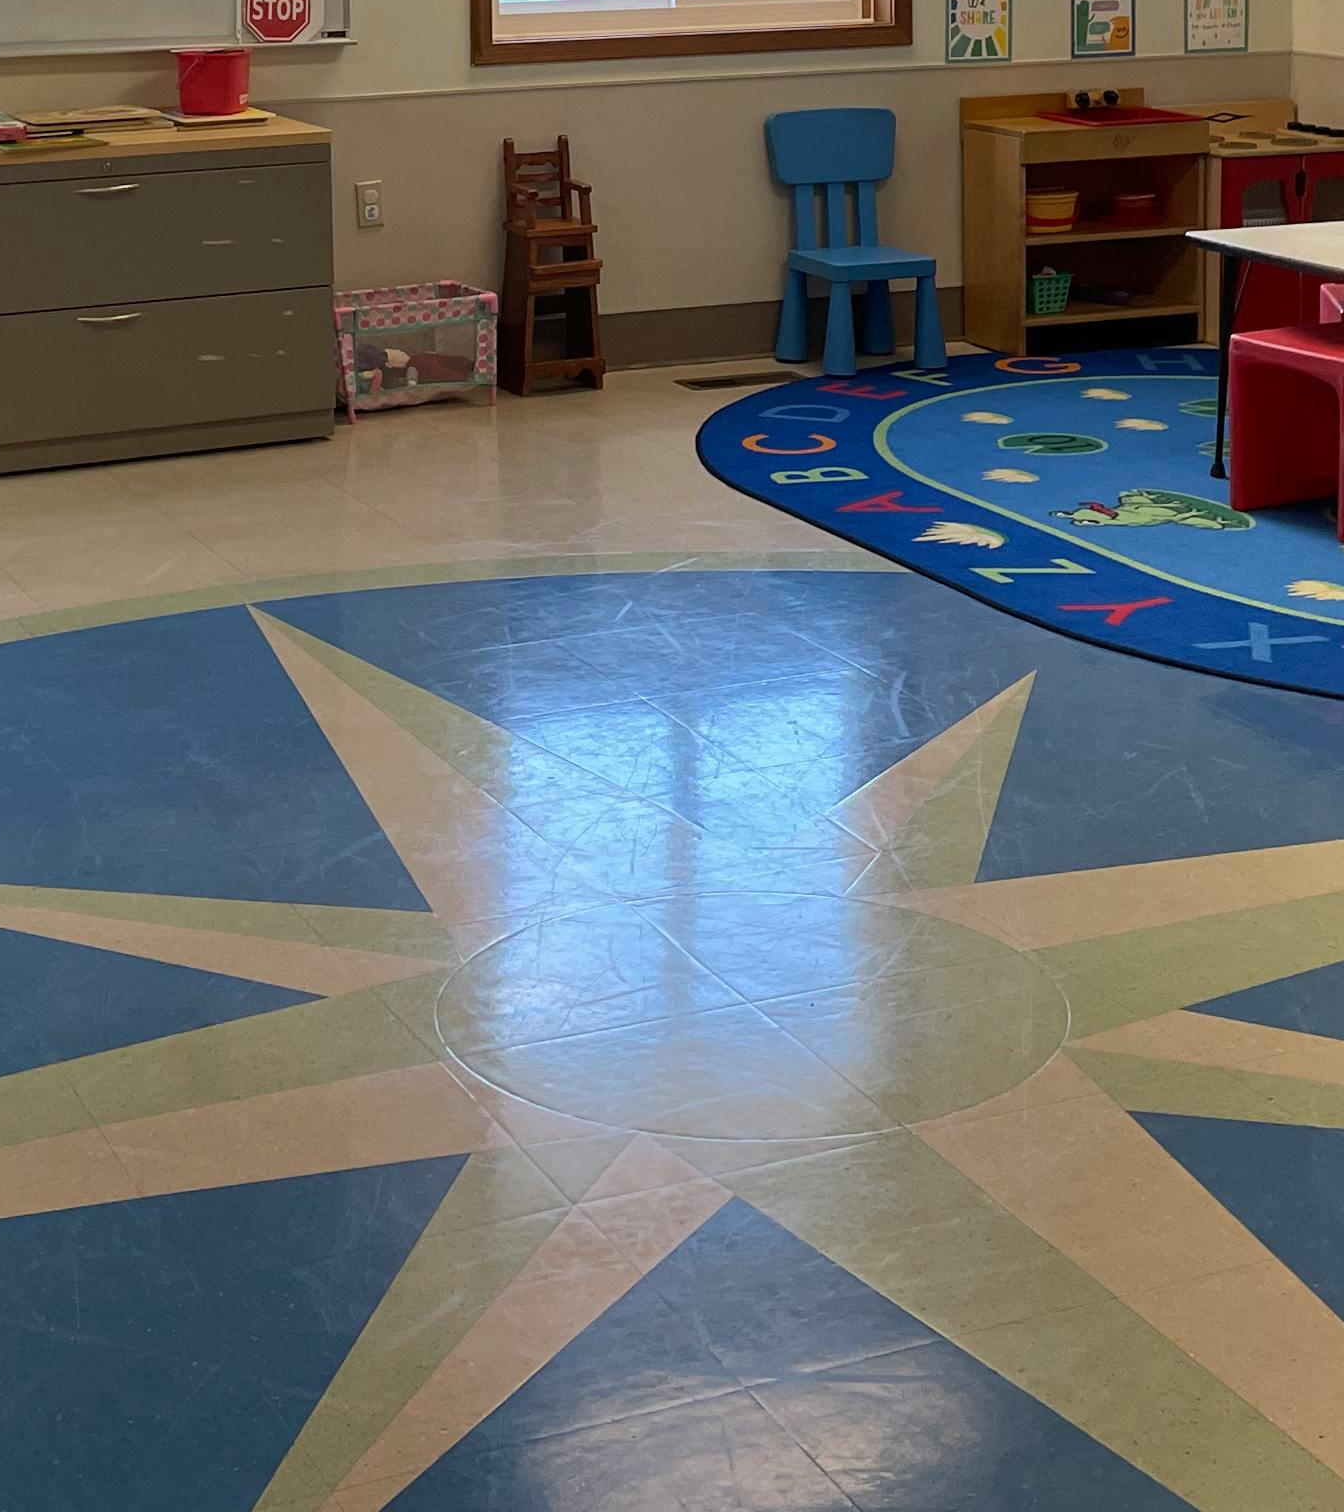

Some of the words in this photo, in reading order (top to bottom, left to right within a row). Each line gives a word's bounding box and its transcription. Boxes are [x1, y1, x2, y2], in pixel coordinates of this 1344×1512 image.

[994, 356, 1082, 376] G
[1136, 353, 1205, 372] H
[889, 369, 953, 387] F
[816, 383, 910, 403] E
[758, 404, 851, 424] D
[742, 433, 837, 455] C
[770, 466, 870, 486] B
[835, 490, 945, 514] A
[969, 558, 1097, 584] Z
[1057, 596, 1175, 627] Y
[1189, 621, 1331, 663] X
